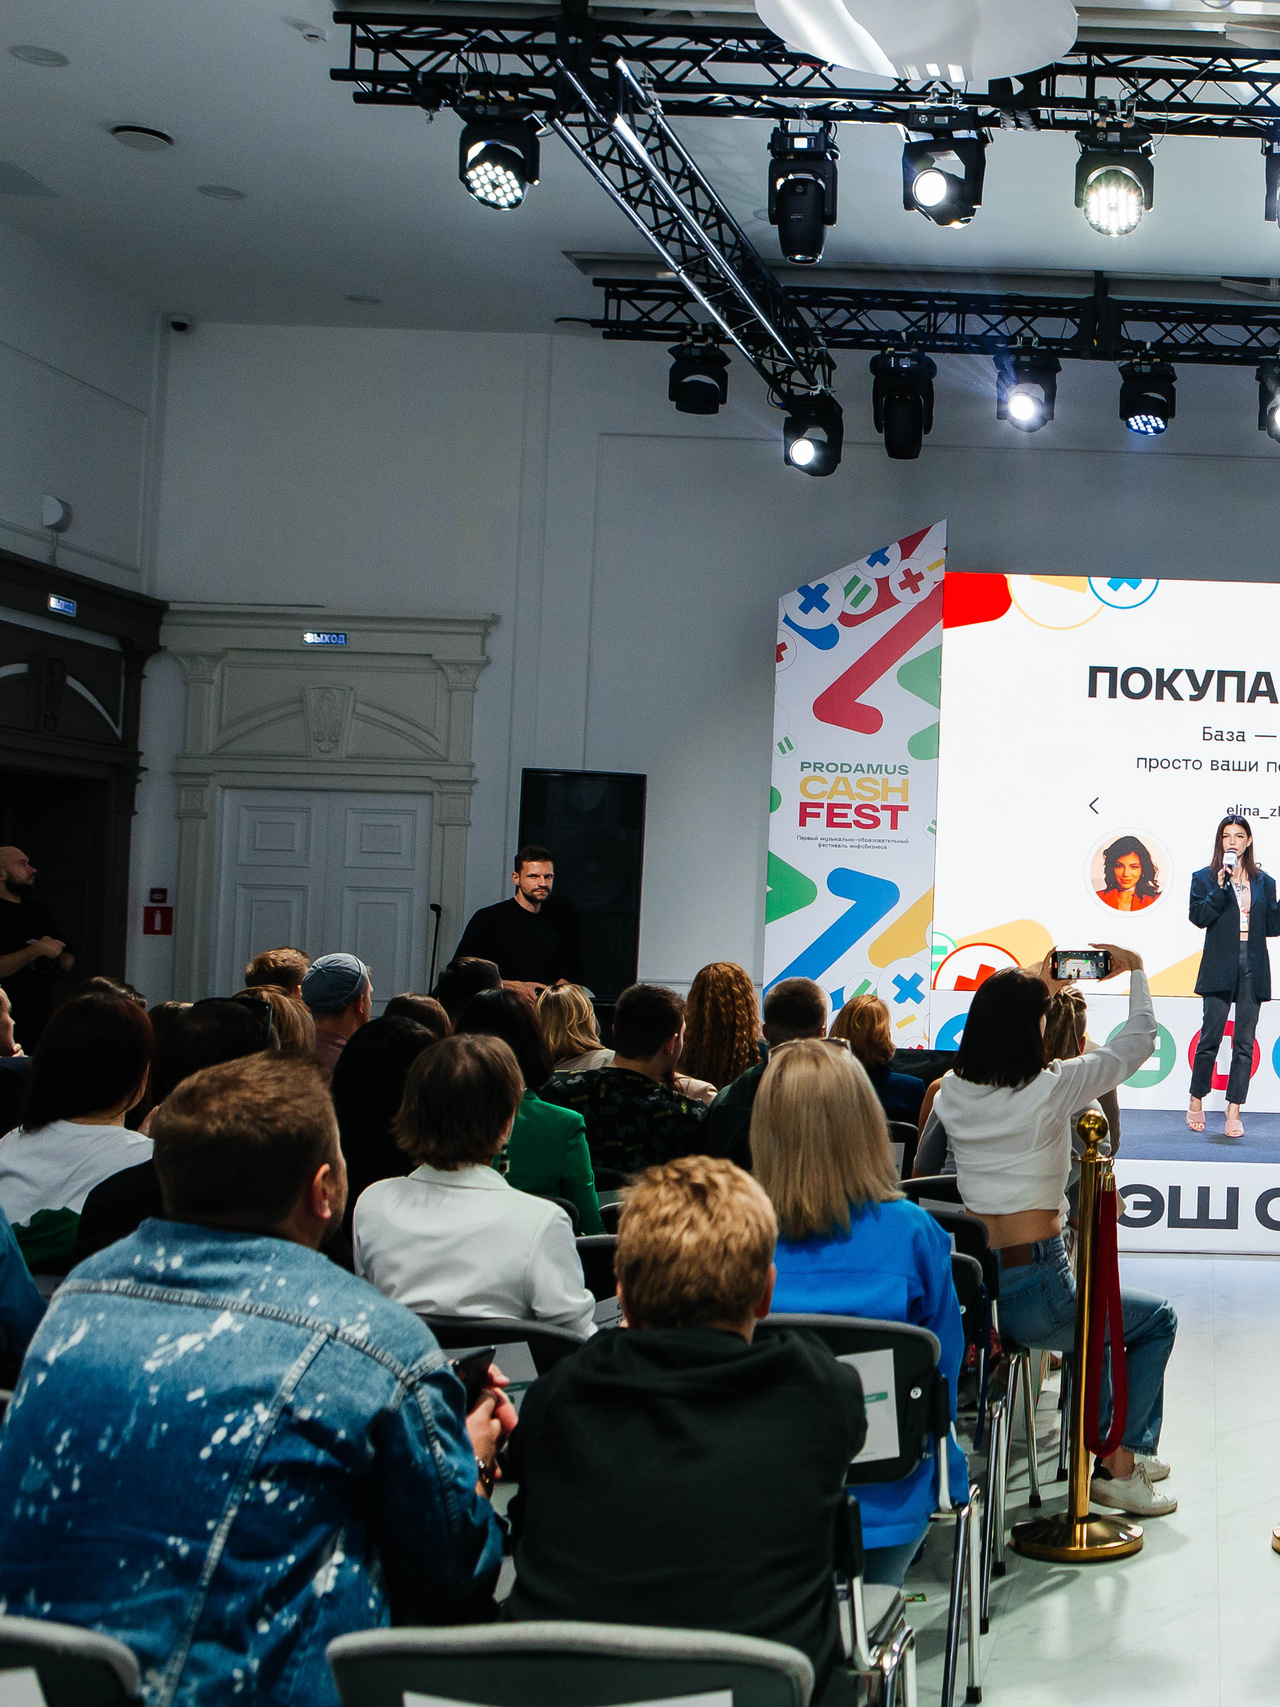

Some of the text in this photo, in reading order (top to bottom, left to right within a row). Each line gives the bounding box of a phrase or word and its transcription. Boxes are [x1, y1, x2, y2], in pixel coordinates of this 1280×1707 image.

[304, 632, 346, 645] ВЫХОД
[1202, 726, 1246, 743] База
[800, 761, 909, 775] PRODAMUS
[1136, 756, 1202, 775] просто
[1210, 758, 1259, 773] ваши
[799, 775, 909, 802] CASH
[798, 802, 909, 830] FEST
[1117, 1184, 1240, 1230] ЭШ
